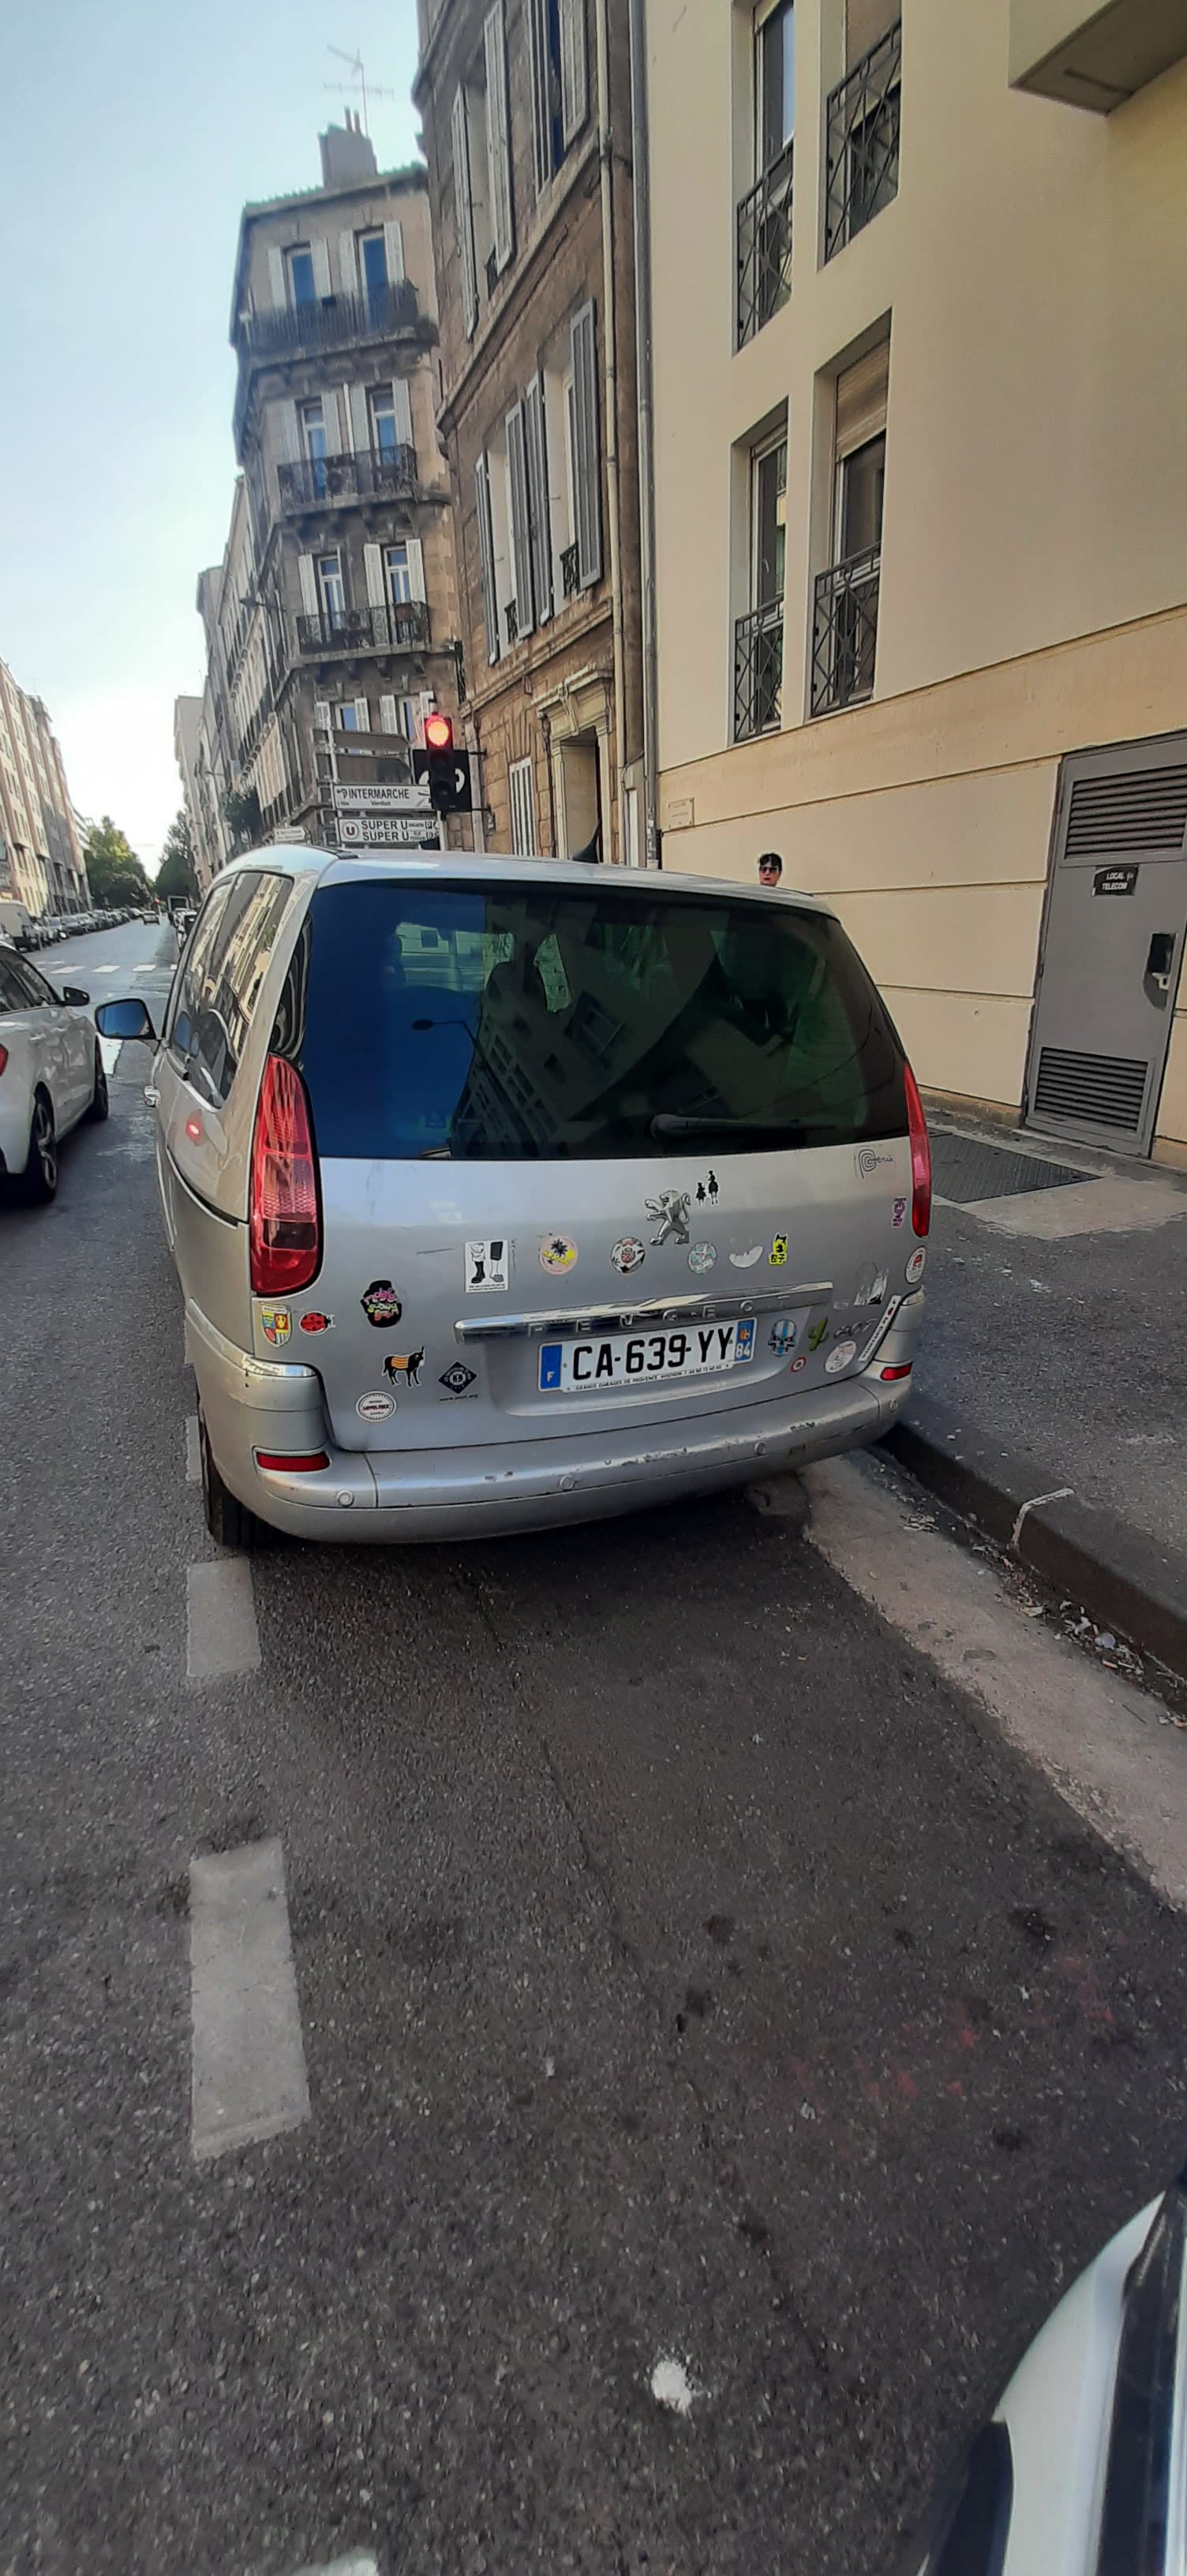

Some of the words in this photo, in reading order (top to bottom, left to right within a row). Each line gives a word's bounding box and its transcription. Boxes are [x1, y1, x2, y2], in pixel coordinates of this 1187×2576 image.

[349, 788, 410, 799] INTERMARCHE
[361, 820, 399, 830] SUPER
[401, 820, 408, 830] U
[346, 826, 355, 836] U
[362, 831, 399, 841] SUPER
[402, 831, 409, 841] U
[528, 1295, 790, 1339] PEUGEOT
[572, 1326, 735, 1381] CA-639-YY
[735, 1342, 751, 1359] 84
[546, 1371, 556, 1383] F
